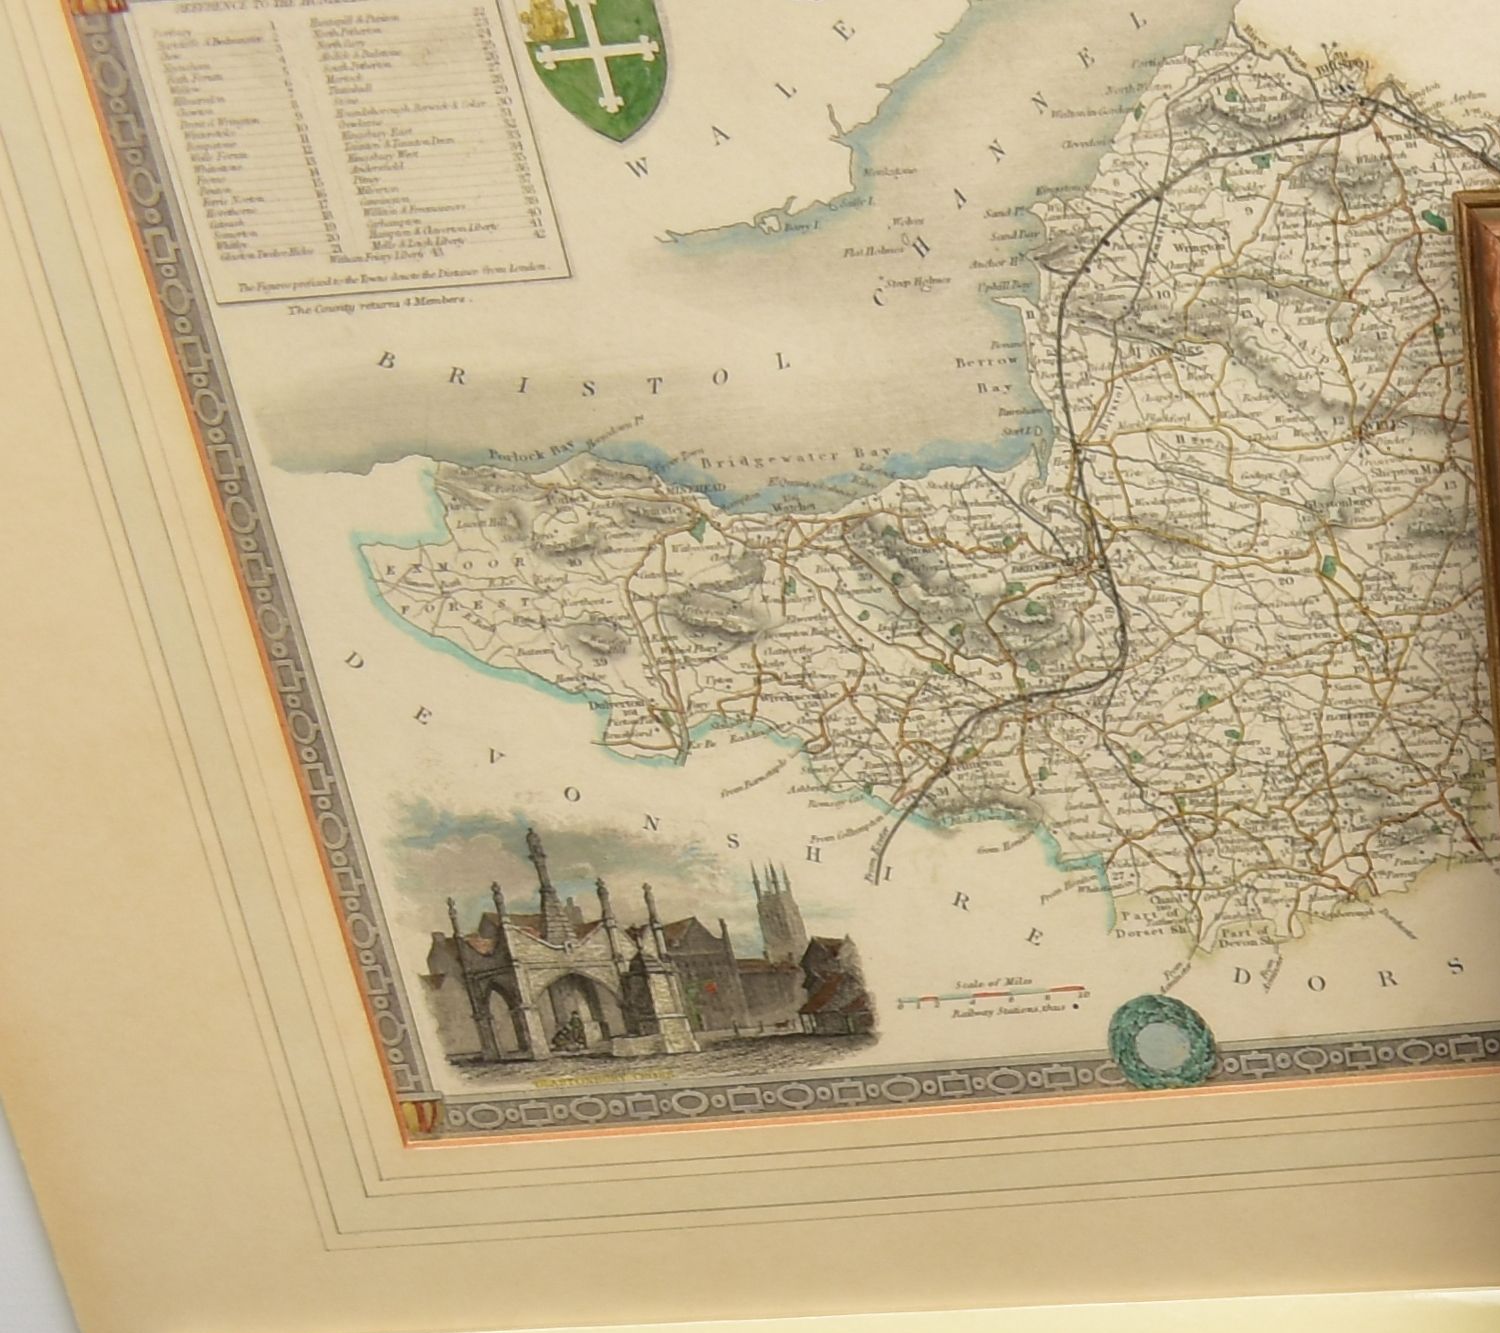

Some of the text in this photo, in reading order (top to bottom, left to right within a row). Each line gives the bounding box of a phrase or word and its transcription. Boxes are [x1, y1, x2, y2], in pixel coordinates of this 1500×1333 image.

[288, 299, 400, 316] The County returns
